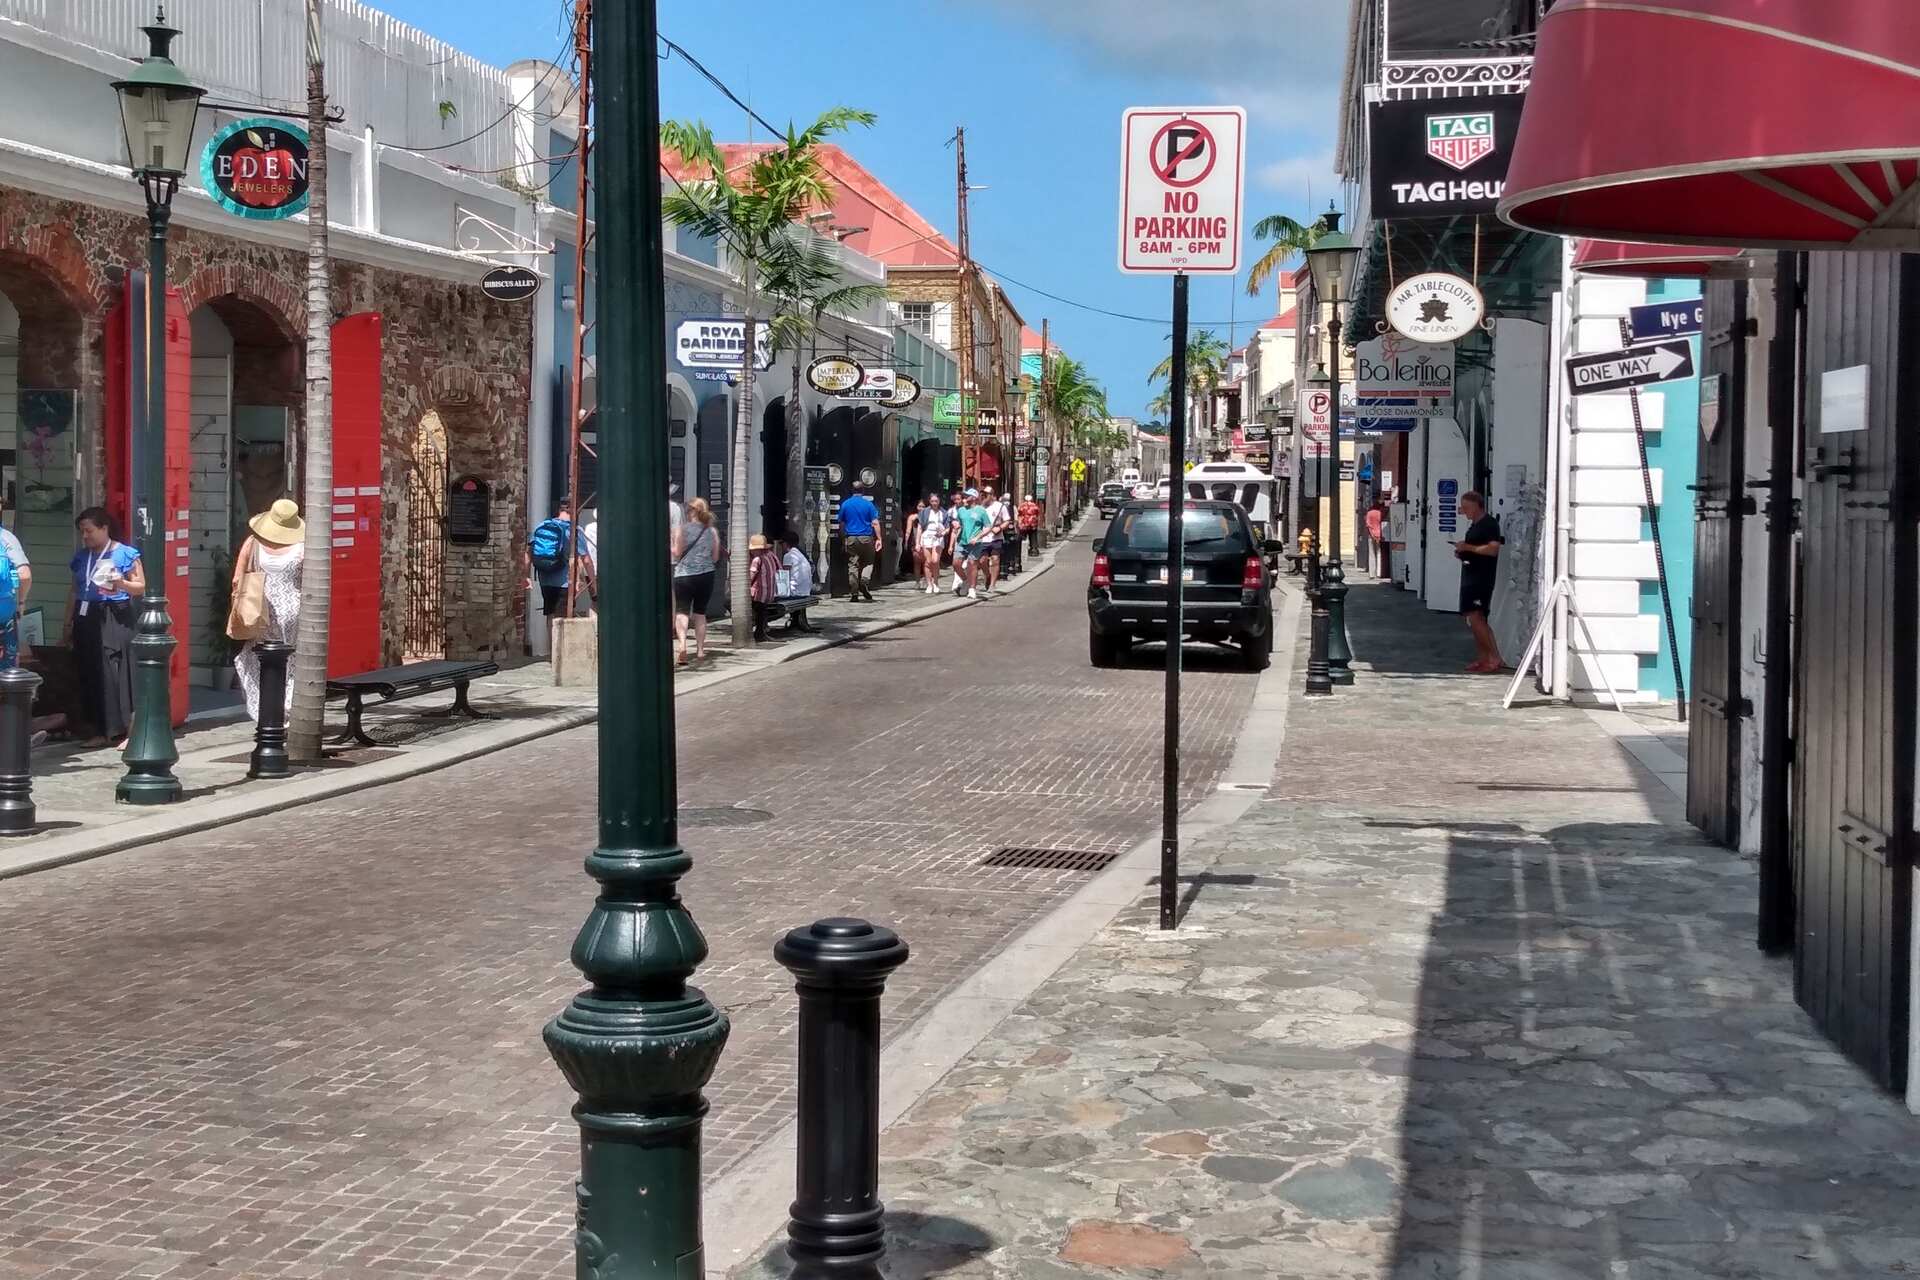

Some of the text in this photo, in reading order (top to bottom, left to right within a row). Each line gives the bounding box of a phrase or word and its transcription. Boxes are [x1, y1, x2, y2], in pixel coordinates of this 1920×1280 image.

[1432, 118, 1488, 136] TAG
[1430, 138, 1489, 165] HEUER
[217, 154, 309, 180] EDEN
[230, 182, 293, 194] JEWELERS
[1164, 191, 1199, 213] NO
[1134, 216, 1227, 239] PARKING
[1139, 241, 1172, 254] 8AM
[1188, 241, 1221, 254] 6PM
[1170, 257, 1188, 265] VIPD
[484, 279, 536, 288] HIBISCUS ALLEY
[1396, 280, 1475, 306] MR. TABLECLOTH
[1660, 307, 1704, 330] Nye G
[700, 326, 746, 338] ROYA
[1408, 324, 1458, 333] FINE LINEN
[680, 338, 771, 350] CARIBBEN
[816, 367, 855, 375] IMPERIAL
[1358, 355, 1451, 382] Ballerina
[1578, 356, 1653, 384] ONE WAY
[695, 373, 728, 381] SUNGLASS
[817, 375, 856, 383] DYNASTY
[1365, 406, 1444, 417] LOOSE DIAMONDS
[1313, 415, 1325, 423] NO
[1303, 423, 1330, 432] PARKIN
